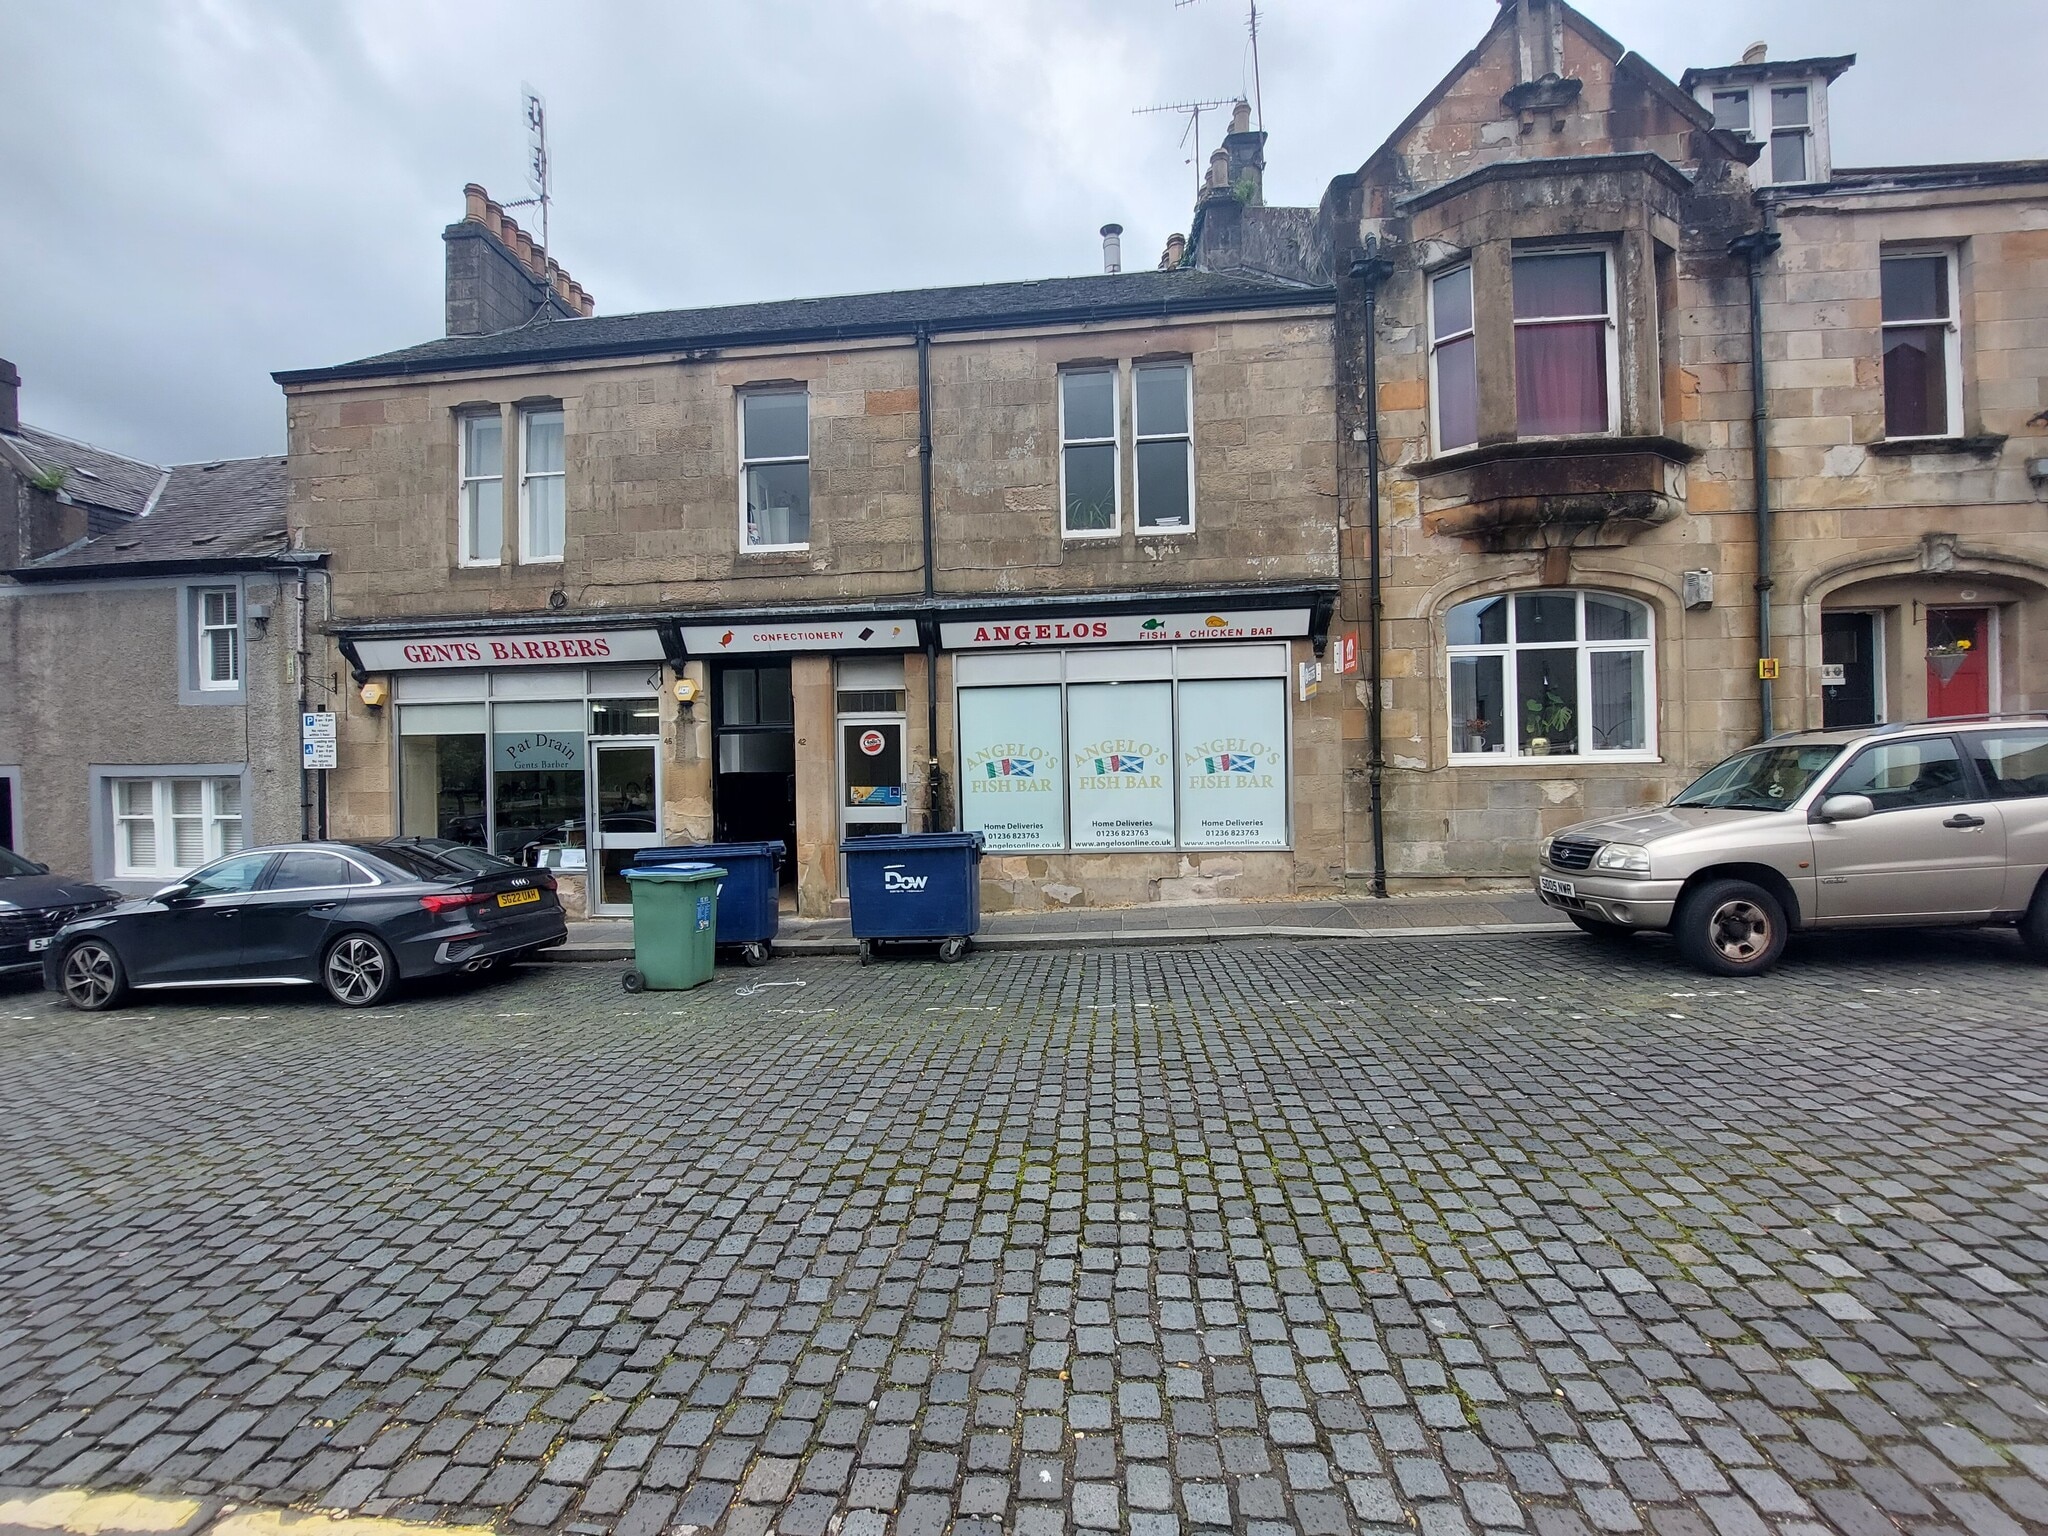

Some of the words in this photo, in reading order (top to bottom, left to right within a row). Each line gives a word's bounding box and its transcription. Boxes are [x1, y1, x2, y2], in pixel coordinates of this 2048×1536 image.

[753, 631, 844, 642] CONFECTIONERY
[973, 622, 1108, 641] ANGELOS
[1139, 631, 1167, 640] FISH
[1174, 630, 1182, 638] &
[1189, 628, 1243, 638] CHICKEN
[1250, 627, 1273, 636] BAR
[403, 642, 481, 663] GENTS
[489, 638, 611, 660] BARBERS
[506, 738, 531, 759] Pat
[535, 733, 575, 760] Drain
[1074, 739, 1168, 768] ANGELO'S
[1184, 738, 1280, 767] ANGELO'S
[514, 760, 538, 769] Gents
[541, 760, 569, 769] Barber
[966, 743, 1058, 772] ANGELO'S
[971, 779, 1012, 793] FISH
[1015, 778, 1053, 793] BAR
[1079, 776, 1120, 790] FISH
[1125, 775, 1163, 789] BAR
[1189, 775, 1231, 789] FISH
[1235, 774, 1274, 788] BAR
[1116, 819, 1153, 827] Deliveries
[1075, 839, 1172, 848] www.angelosonline.co.uk
[1183, 838, 1282, 846] www.angelosonlinecouk
[885, 871, 928, 889] Dow
